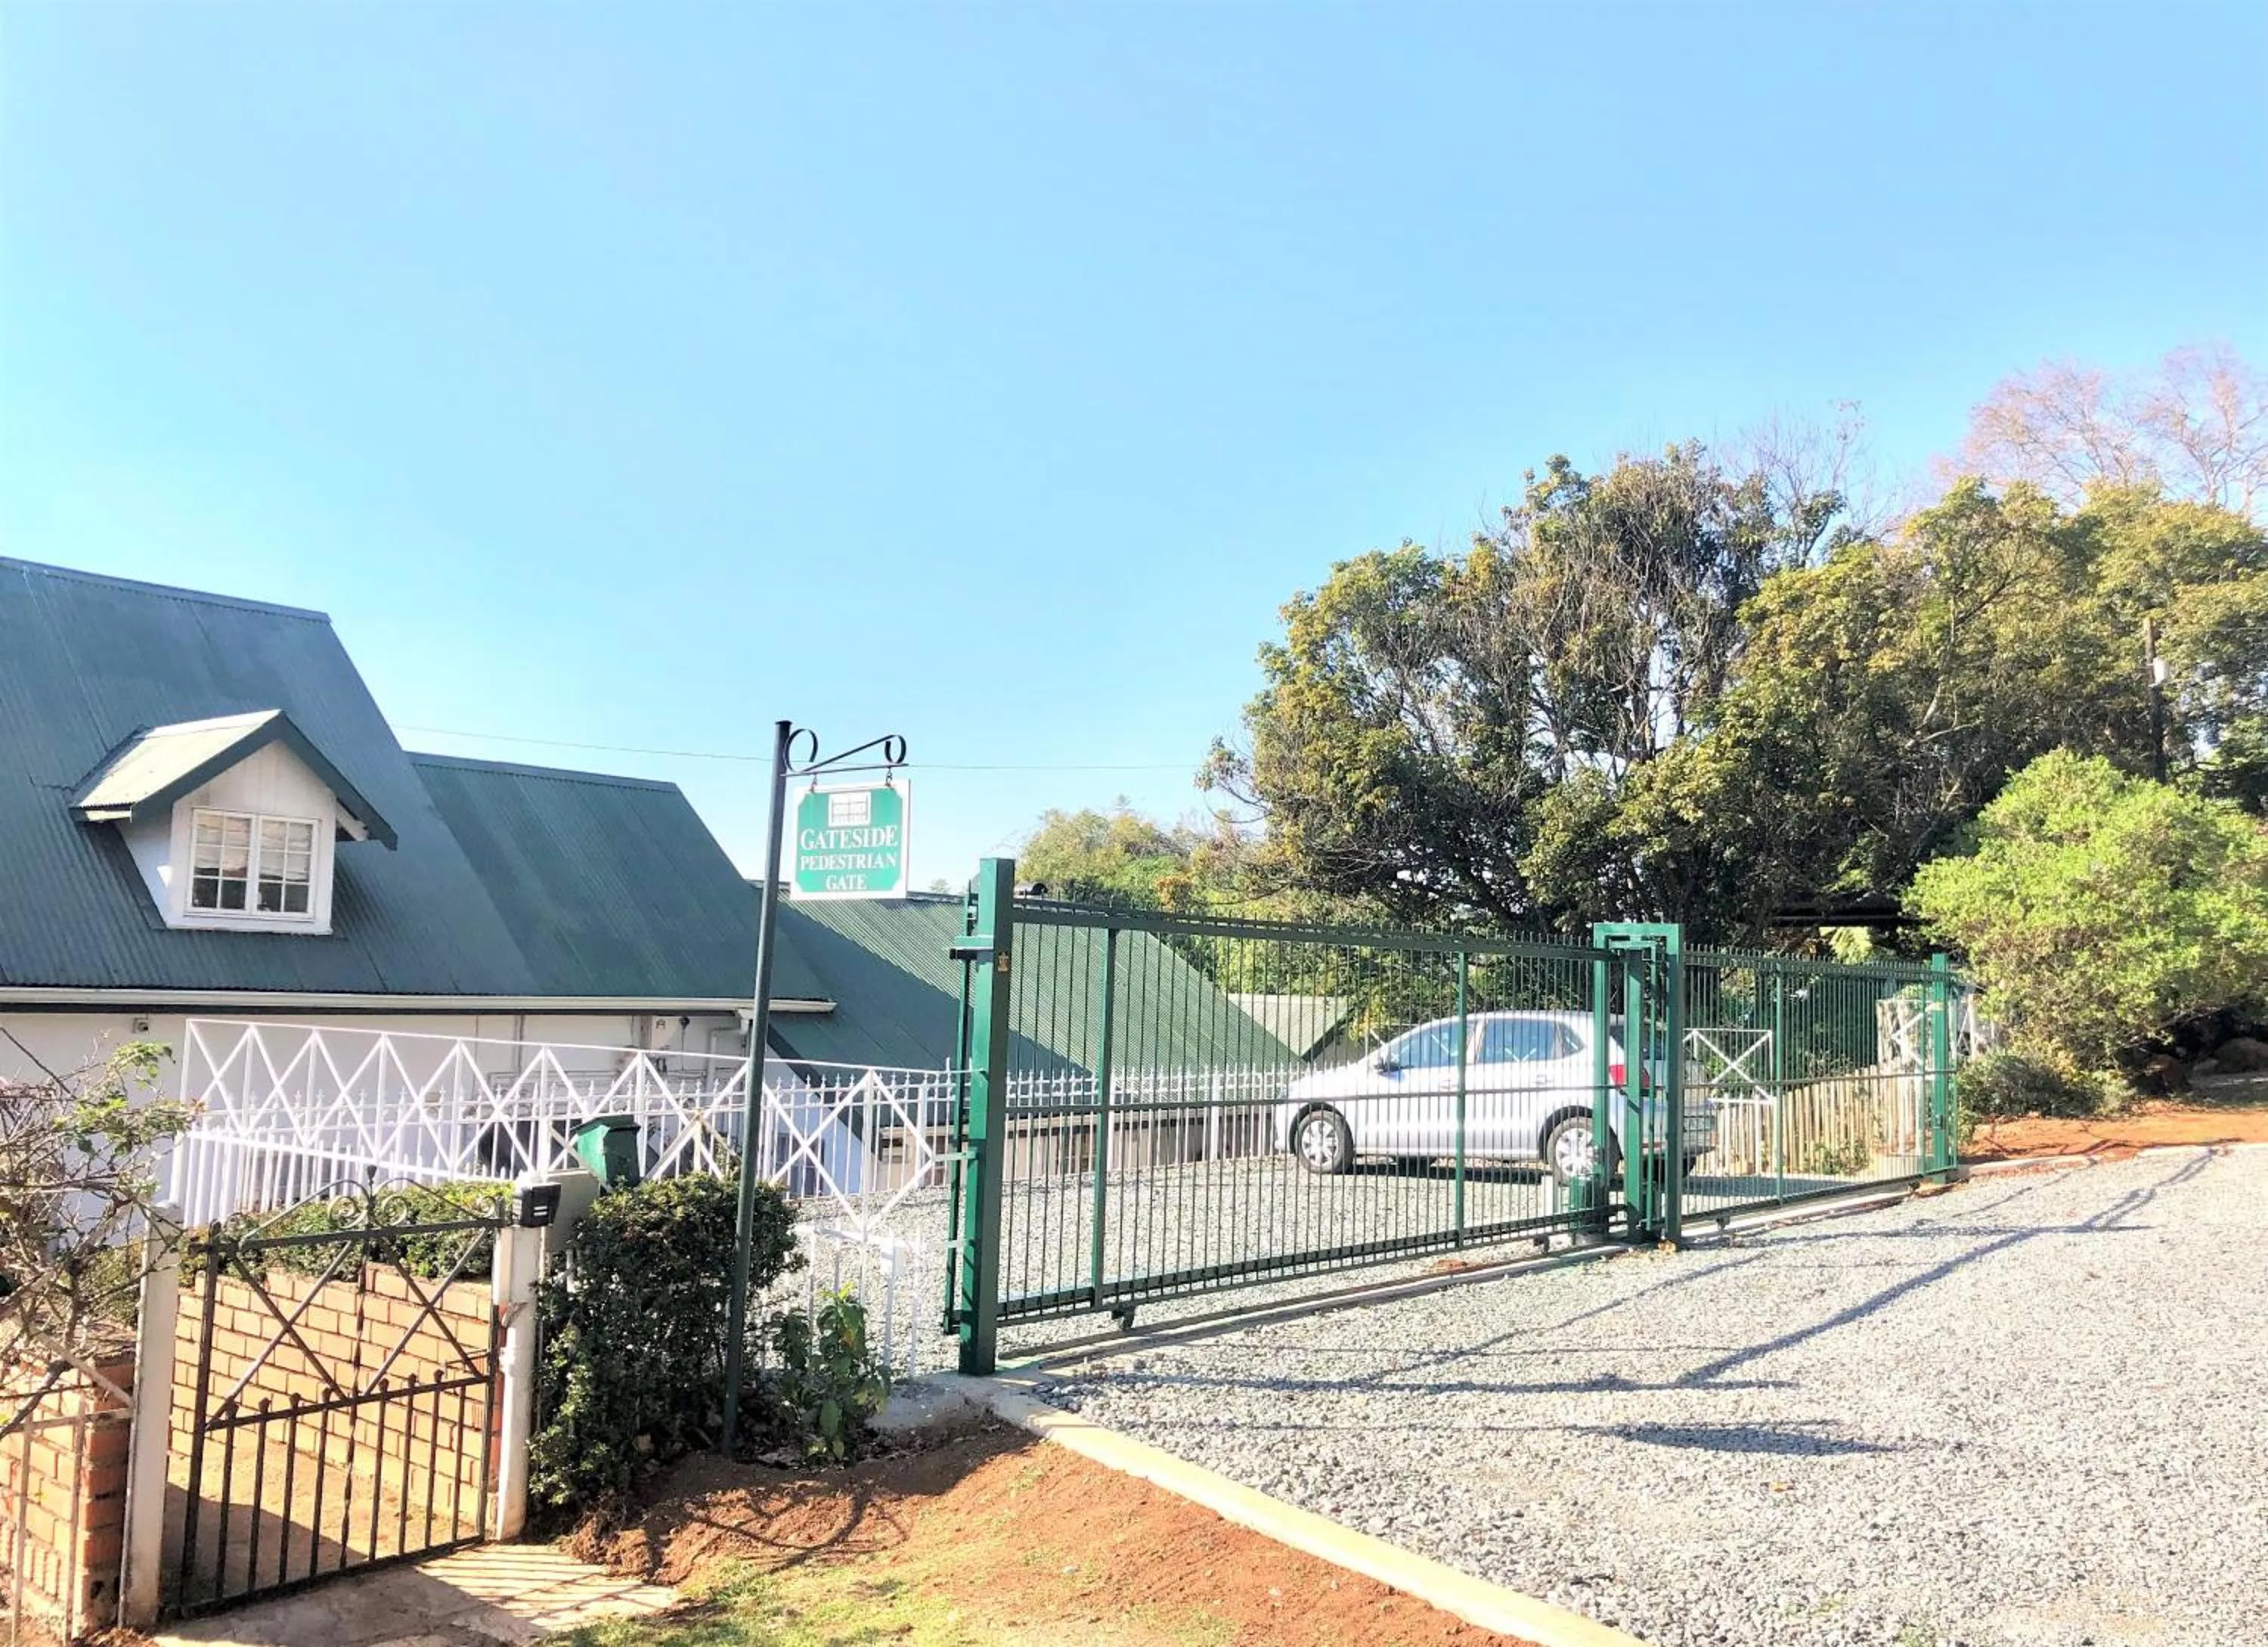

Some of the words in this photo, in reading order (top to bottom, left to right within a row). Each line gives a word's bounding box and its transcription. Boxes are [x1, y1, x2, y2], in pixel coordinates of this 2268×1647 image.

[801, 826, 897, 850] GATESIDE
[801, 853, 896, 870] PEDESTRIAN
[826, 875, 866, 890] GATE
